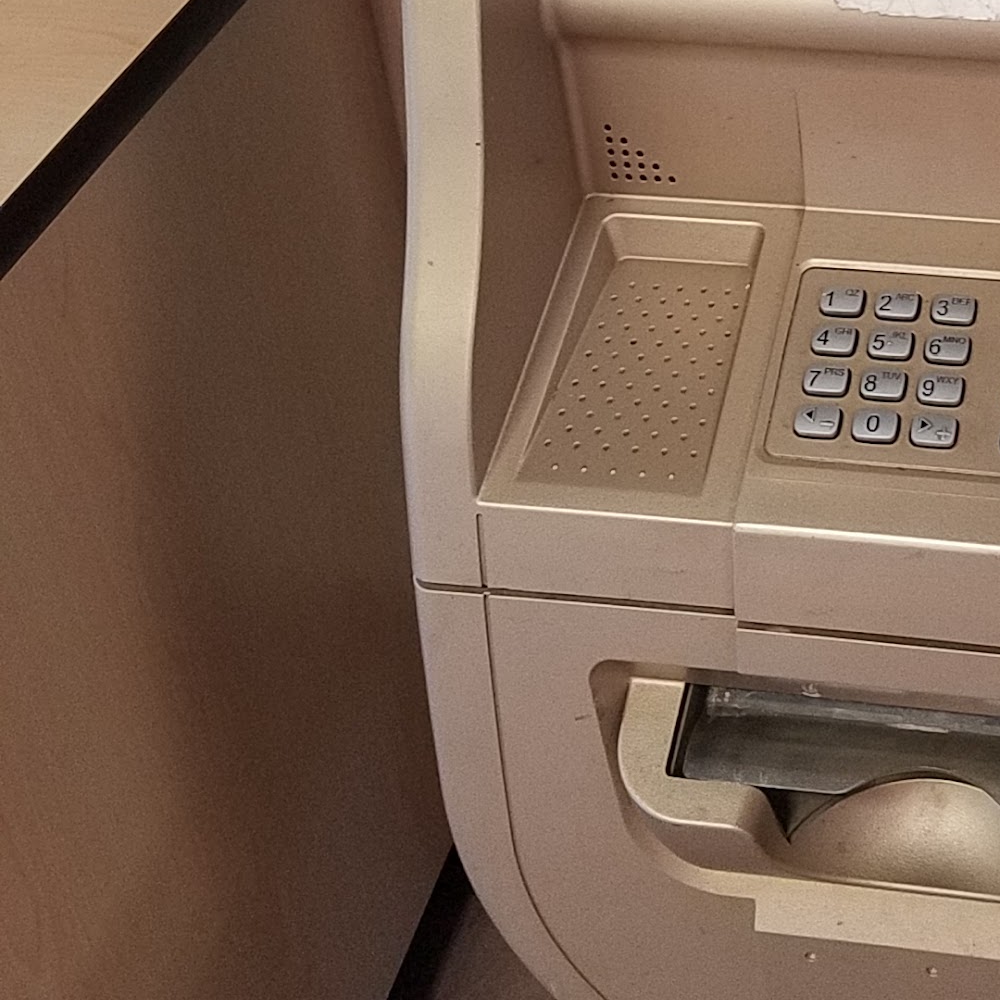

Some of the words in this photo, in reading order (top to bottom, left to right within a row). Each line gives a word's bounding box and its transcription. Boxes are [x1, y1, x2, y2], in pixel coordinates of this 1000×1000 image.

[825, 291, 834, 306] 1
[879, 295, 892, 311] 2
[936, 300, 948, 316] 3
[817, 329, 829, 346] 4
[872, 334, 886, 350] 5
[929, 338, 942, 355] 6
[809, 370, 821, 387] 7
[864, 375, 878, 392] 8
[922, 380, 935, 396] 9
[866, 415, 880, 432] 0
